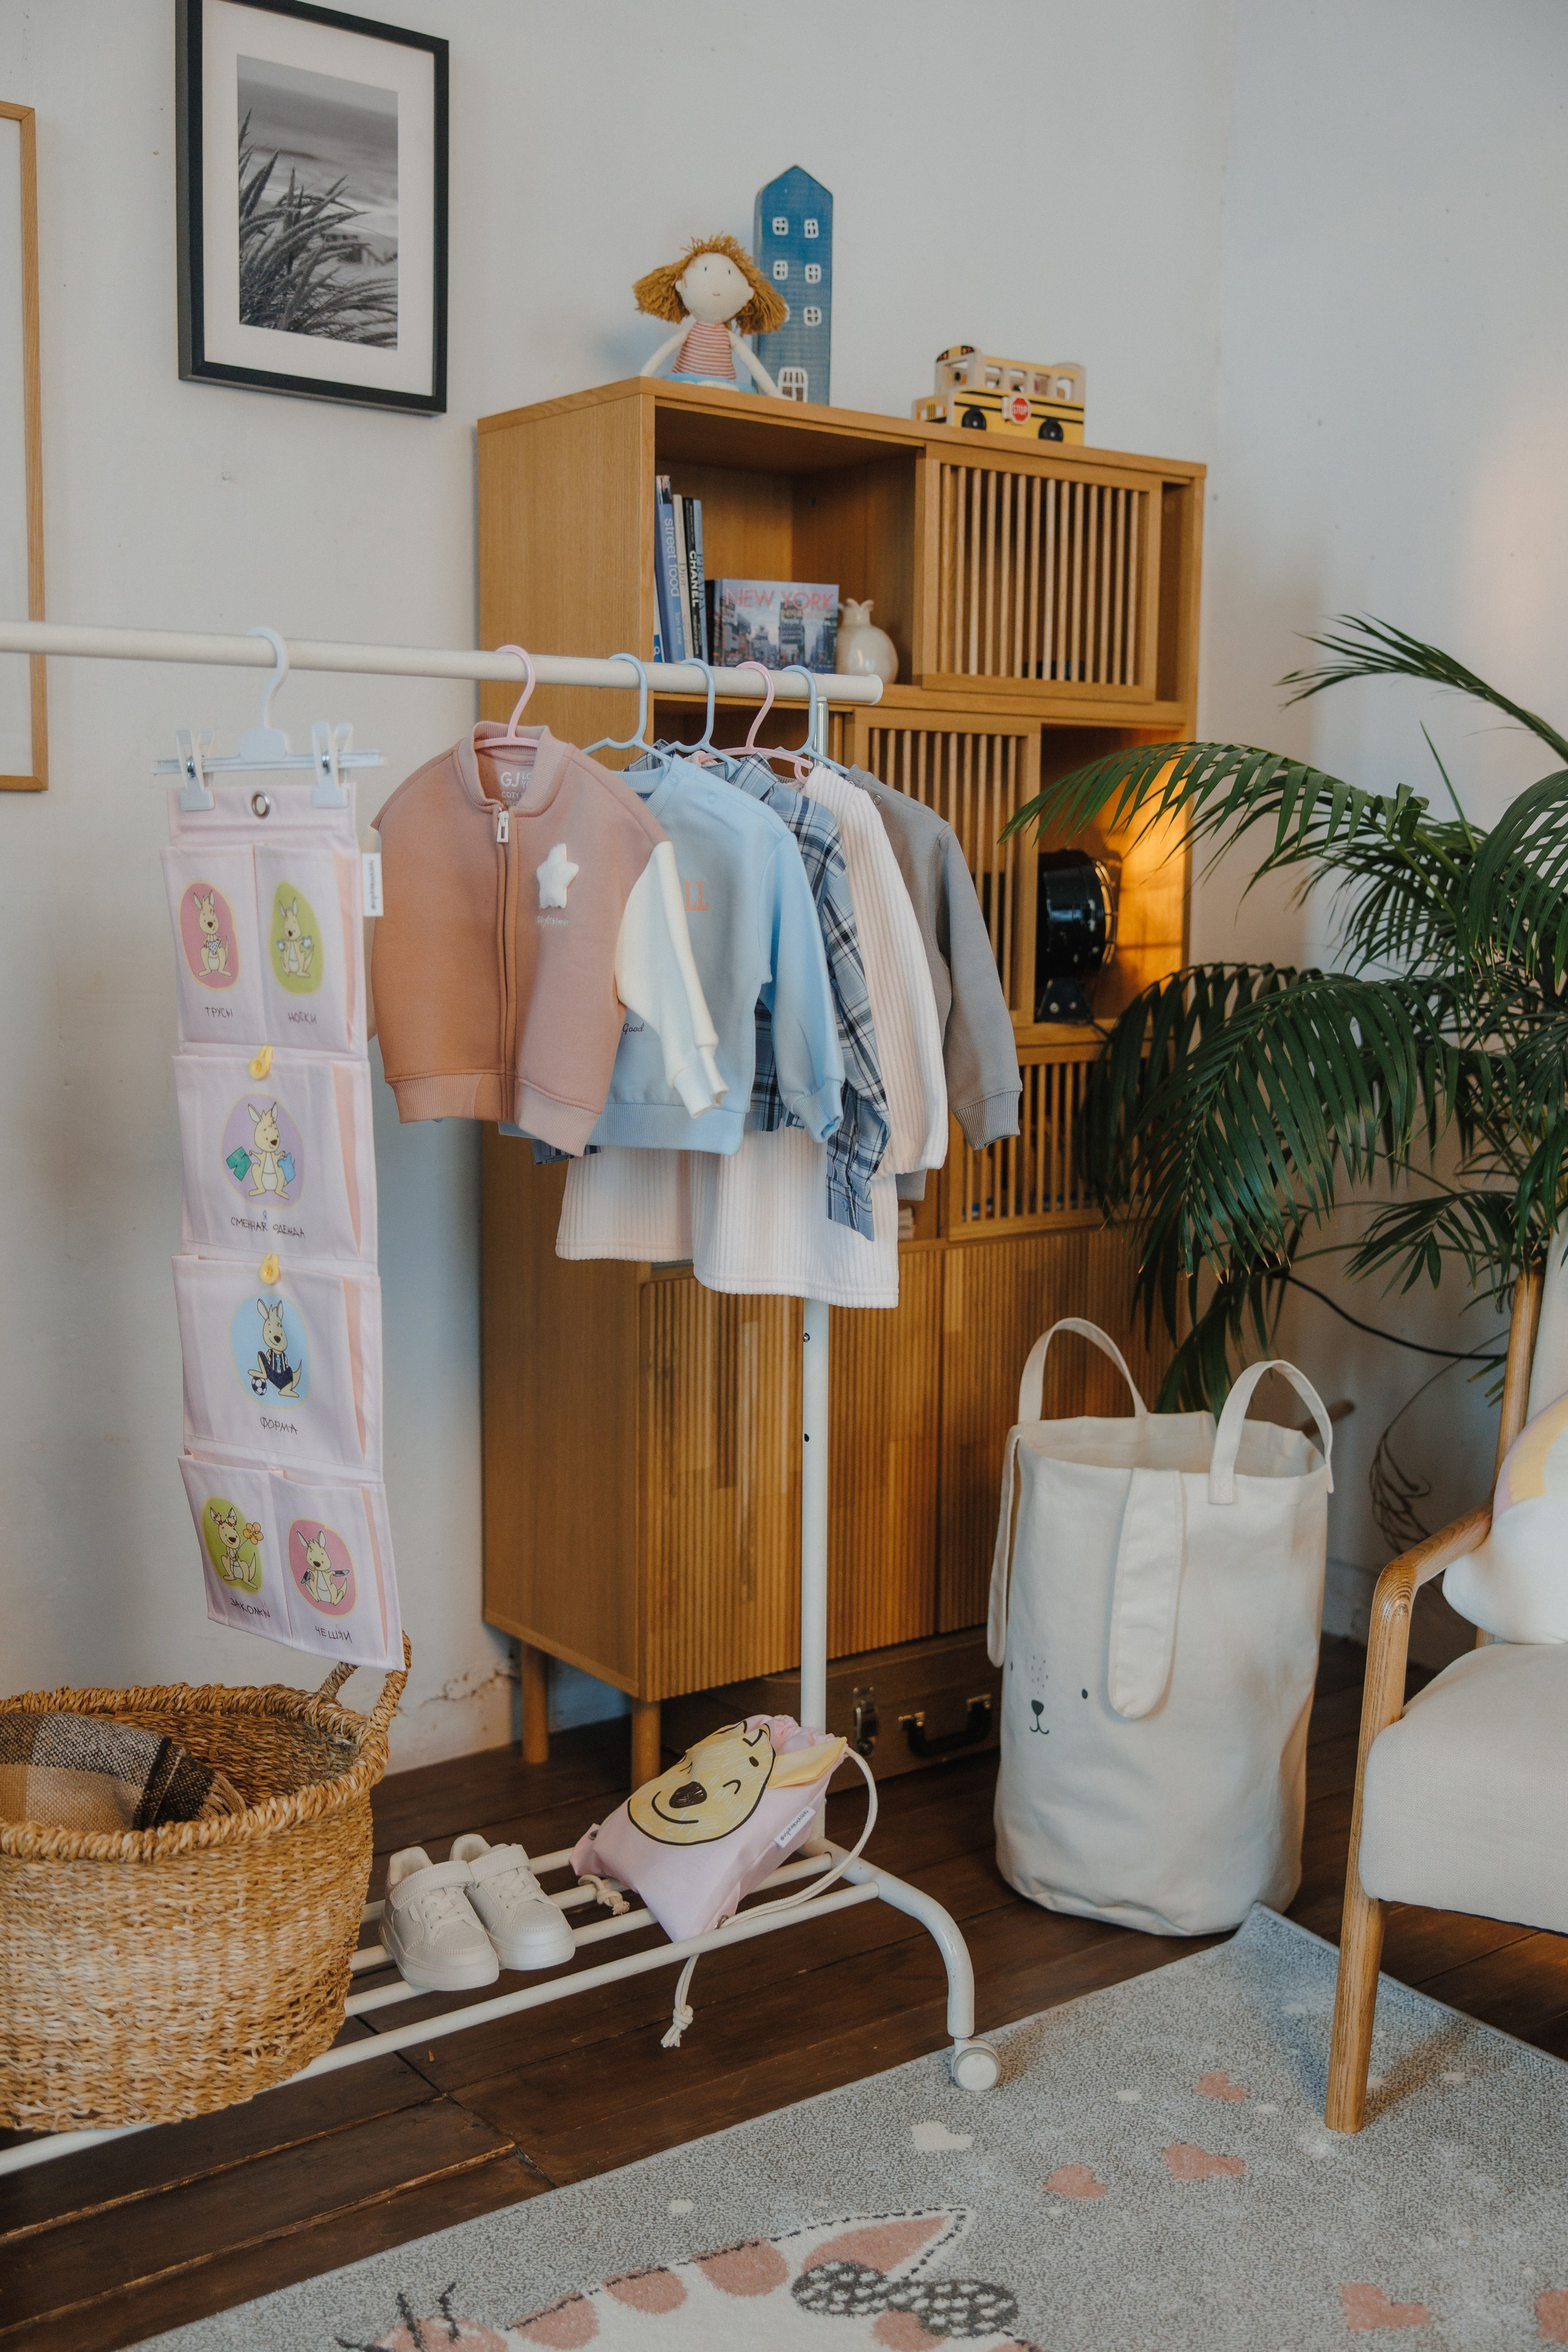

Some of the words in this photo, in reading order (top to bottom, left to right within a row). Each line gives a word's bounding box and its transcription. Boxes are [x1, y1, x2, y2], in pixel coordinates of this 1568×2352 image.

[1012, 404, 1028, 415] STOP
[664, 518, 676, 559] street
[669, 564, 680, 597] food
[688, 550, 700, 608] CHANEL
[726, 587, 775, 607] NEW
[780, 590, 834, 611] YORK
[500, 771, 520, 788] GJ
[205, 1006, 233, 1018] ТРУСЫ
[288, 1011, 317, 1024] НОСКИ
[622, 1022, 644, 1035] Good
[273, 1224, 306, 1238] ОДЕЖДА
[260, 1417, 298, 1435] ФОРМА
